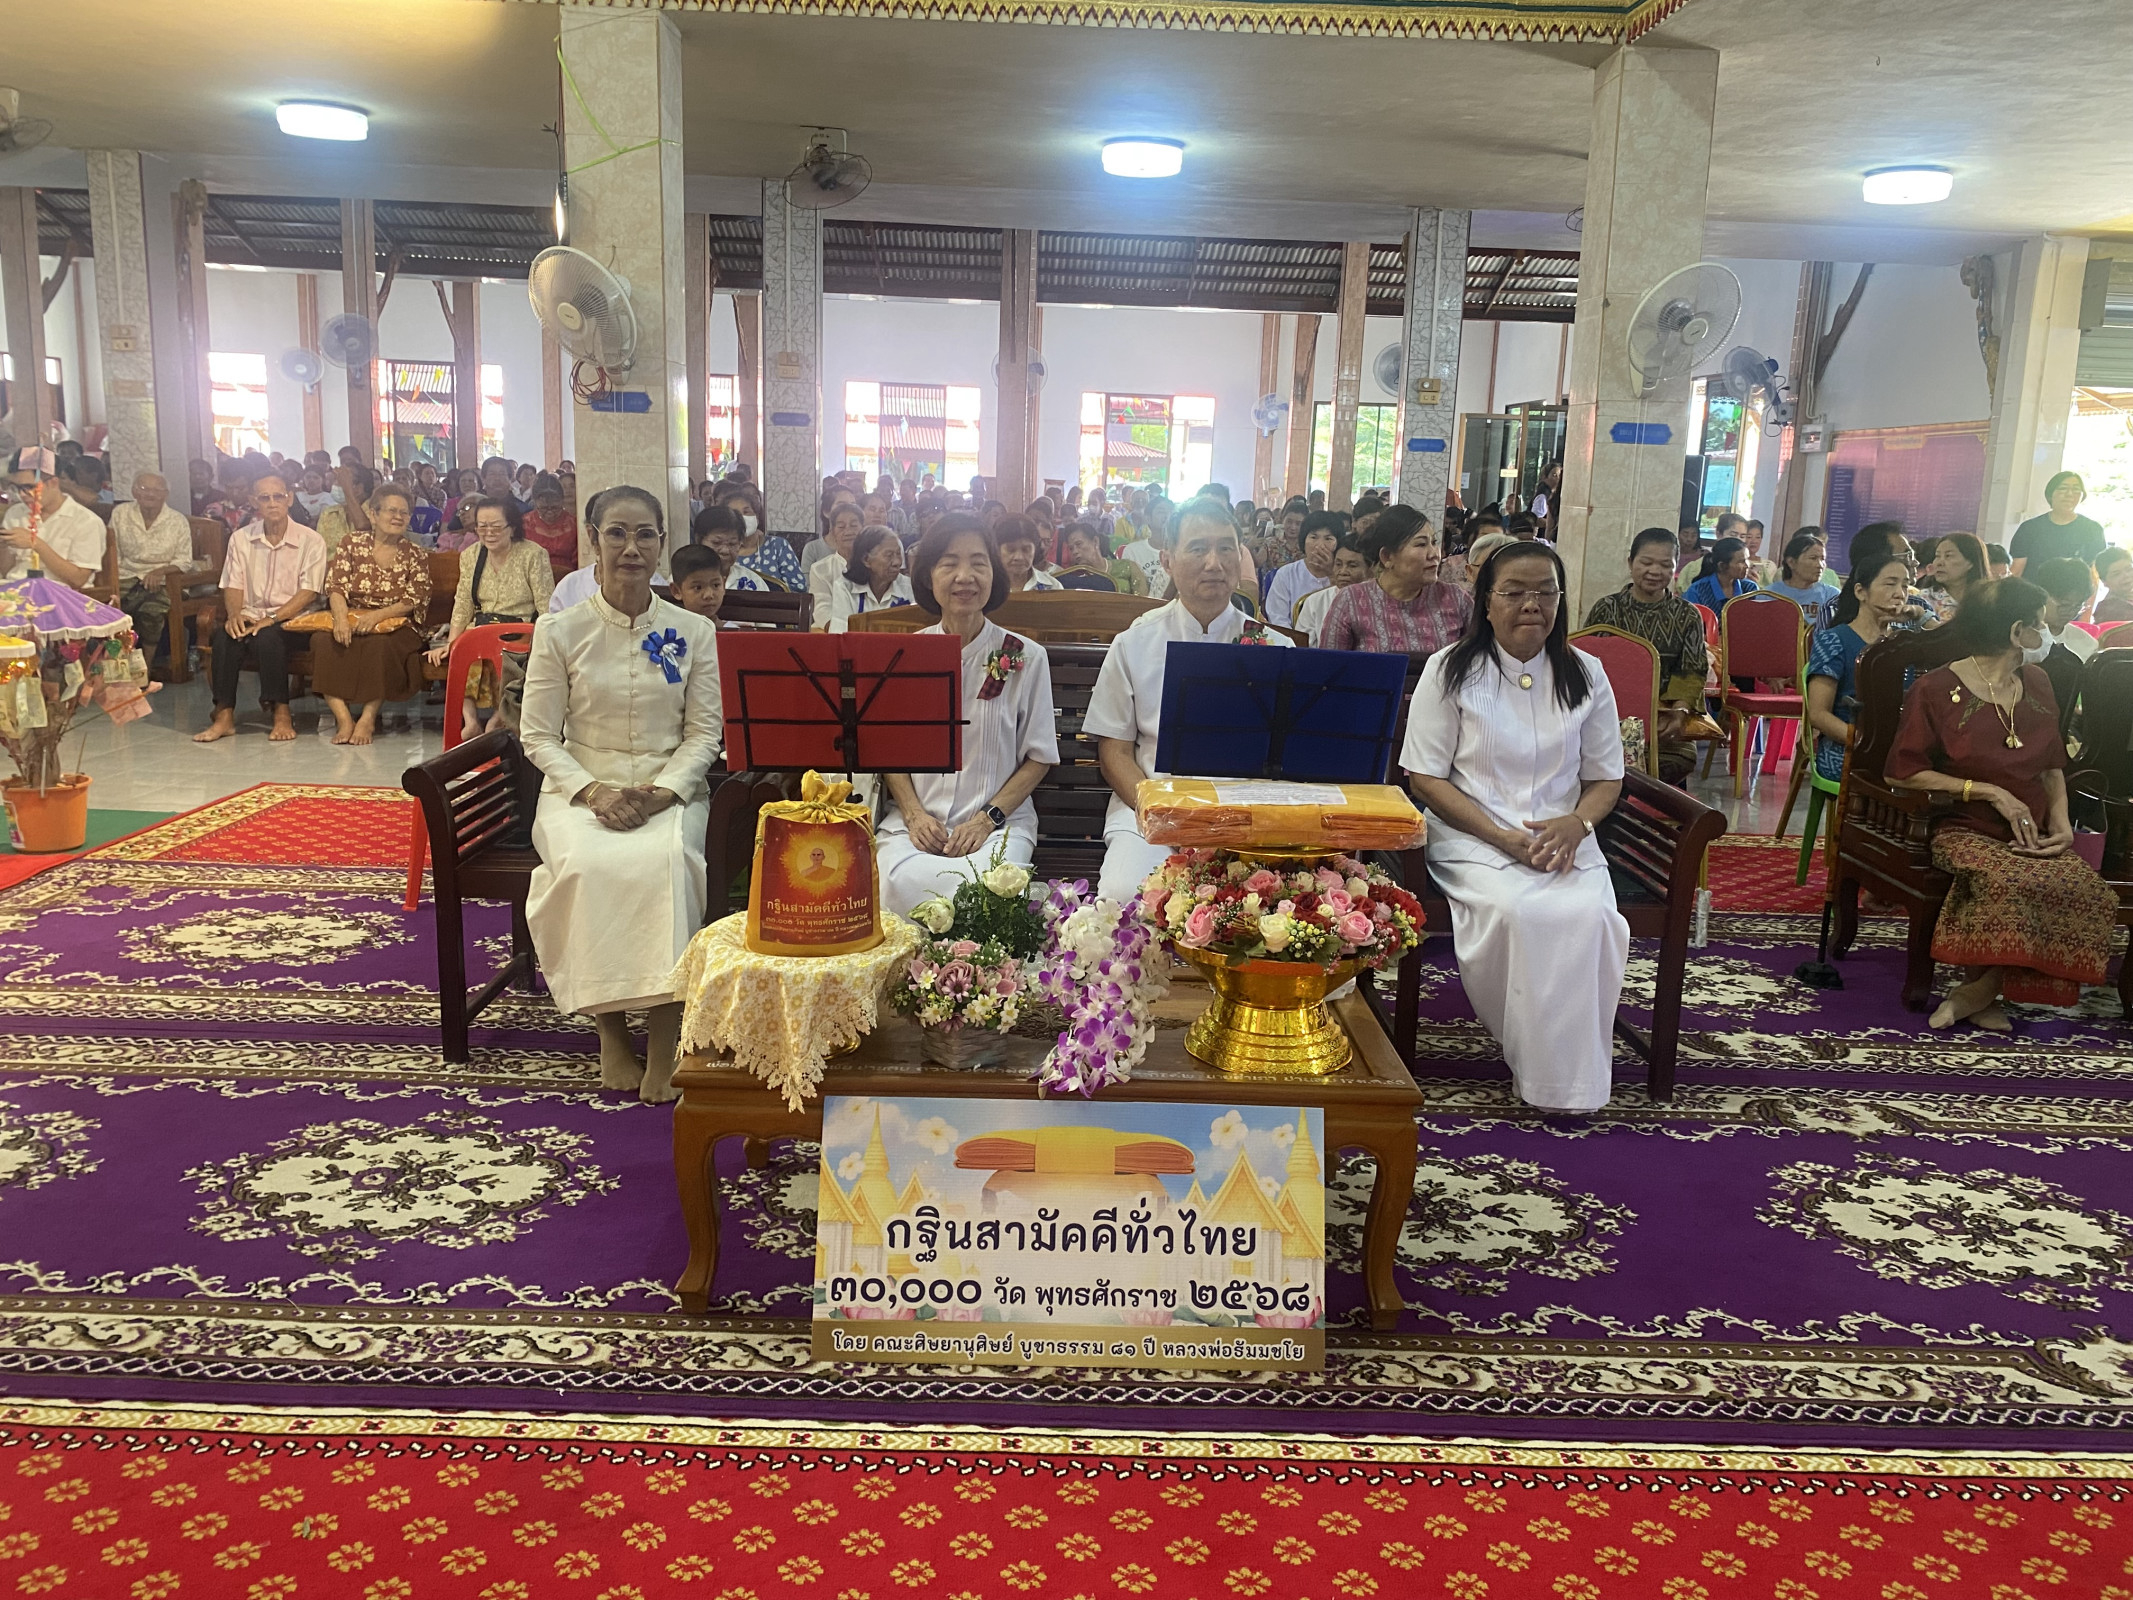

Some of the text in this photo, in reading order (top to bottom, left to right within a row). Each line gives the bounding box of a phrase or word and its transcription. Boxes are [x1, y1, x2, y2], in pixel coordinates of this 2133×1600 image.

[886, 1197, 1257, 1263] กฐินสามัคคีทั่วไทย
[831, 1276, 1310, 1316] ๓๐,๐๐๐ วัด พุทธศักราช ๒๕๖๘
[833, 1330, 1304, 1361] โดย คณะศิษยานุศิษย์ บูชาธรรม ๘๑ ปี หลวงพ่อธัมมชโย
